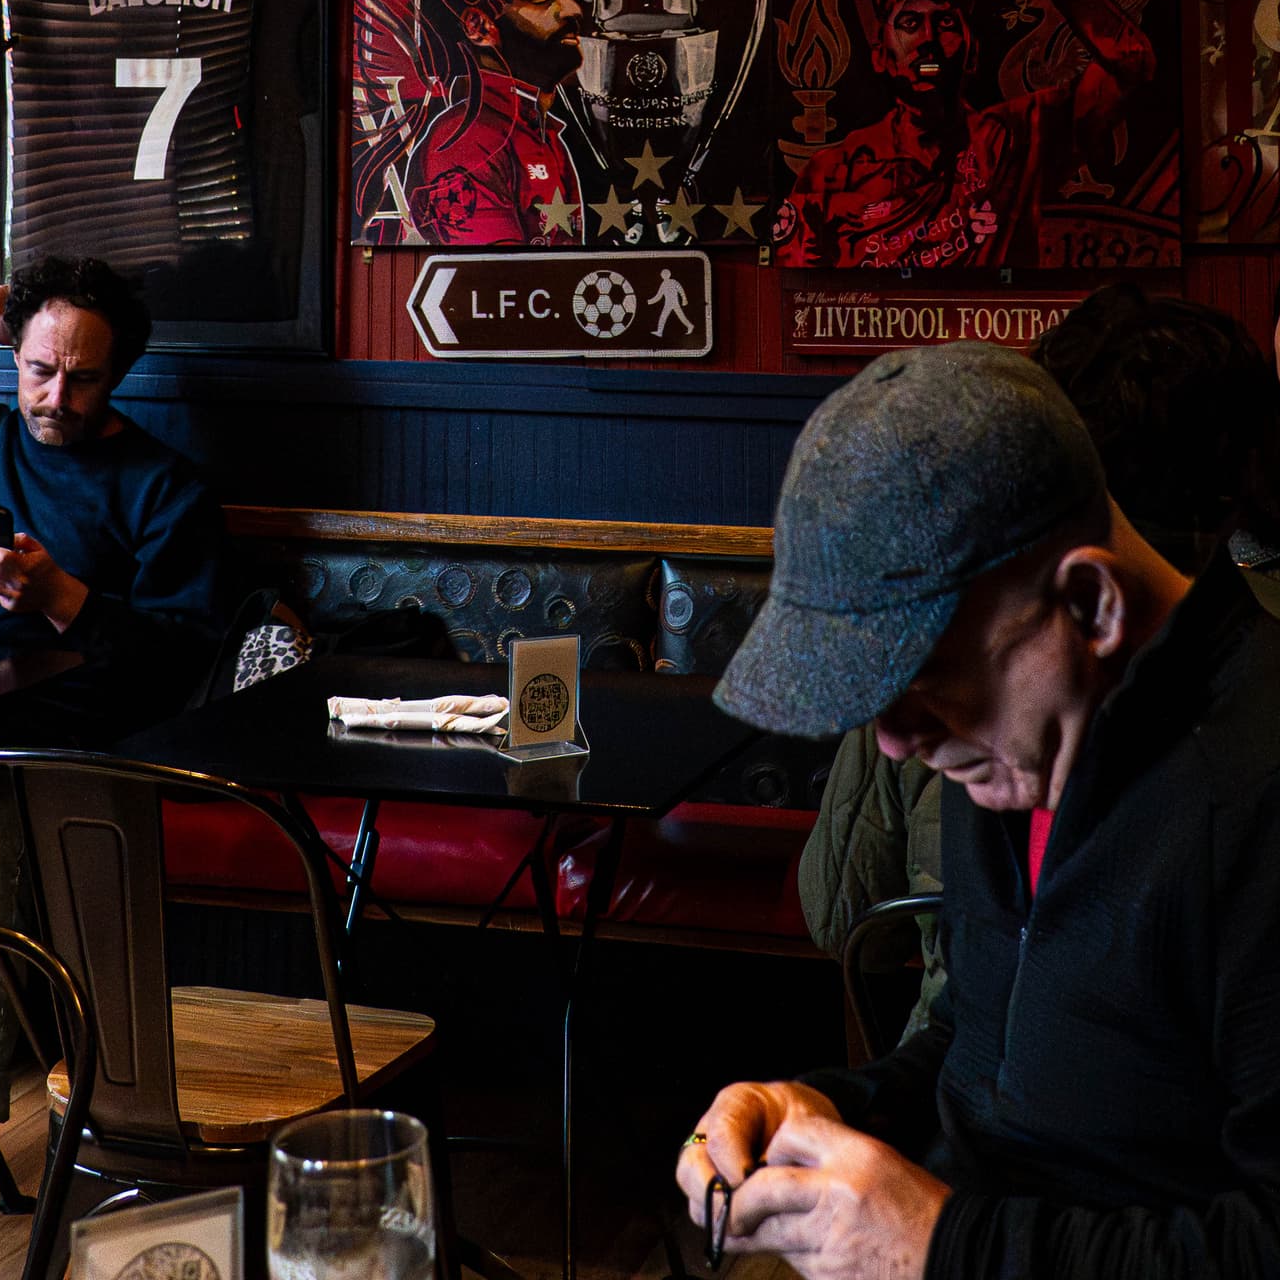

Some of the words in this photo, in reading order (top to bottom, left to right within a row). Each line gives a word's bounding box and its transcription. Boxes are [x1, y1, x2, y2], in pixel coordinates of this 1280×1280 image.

[115, 57, 202, 181] 7
[864, 207, 965, 254] Standard
[471, 288, 561, 320] L.F.C.
[813, 306, 949, 340] LIVERPOOL
